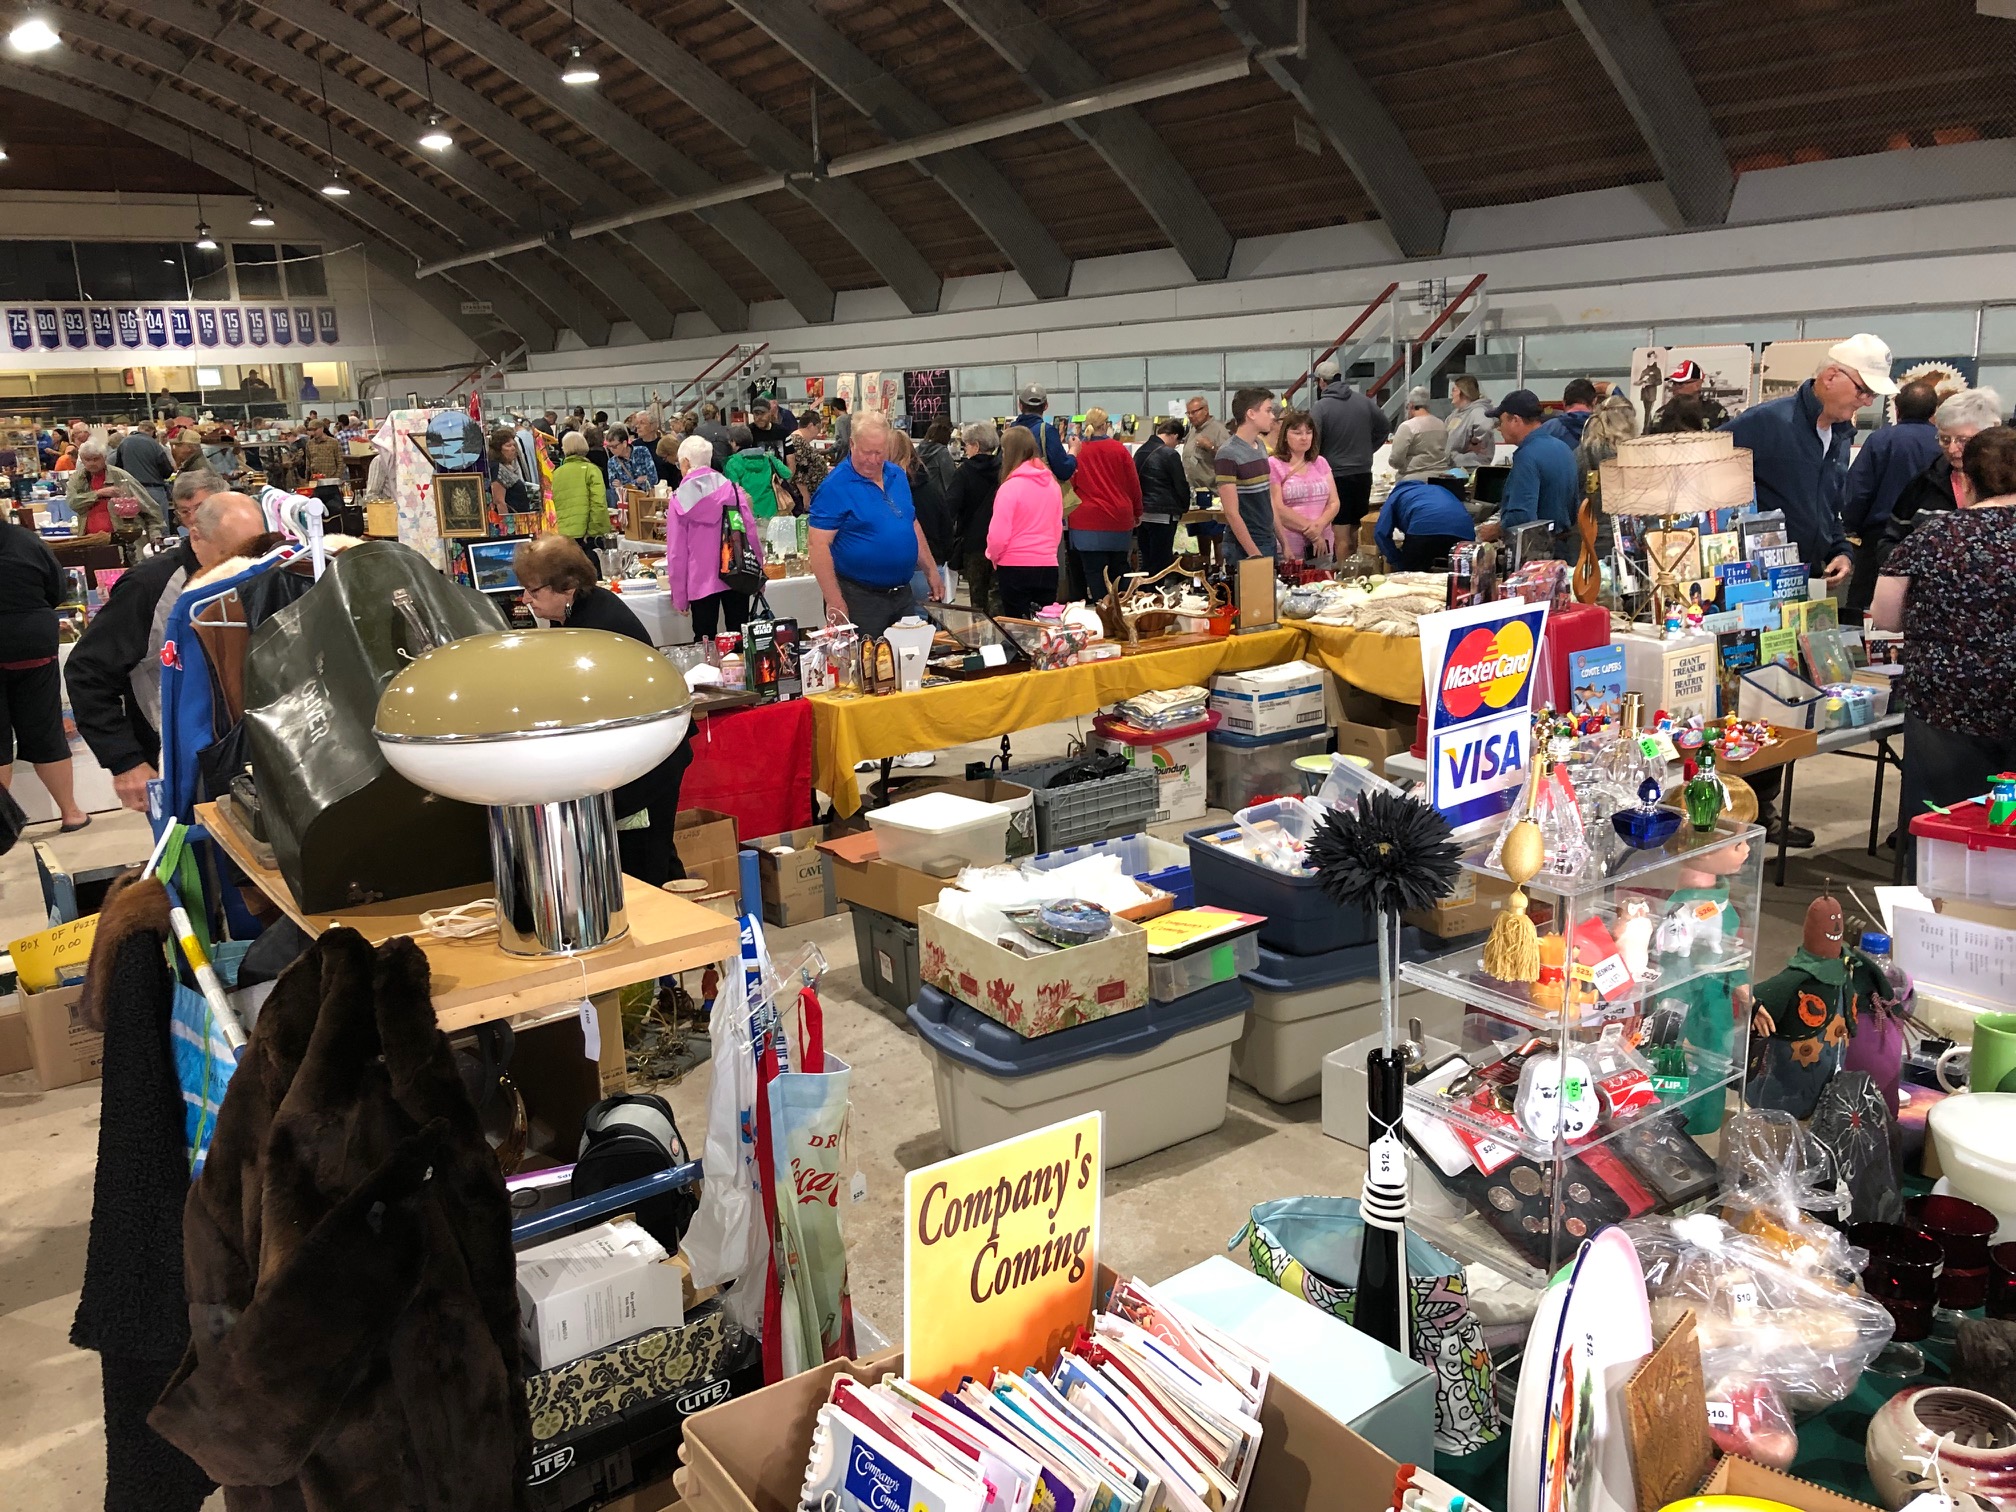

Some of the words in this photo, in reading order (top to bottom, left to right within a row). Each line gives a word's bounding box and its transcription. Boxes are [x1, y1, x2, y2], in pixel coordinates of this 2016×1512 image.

[1726, 568, 1748, 577] Three
[1776, 576, 1804, 589] TRUE
[1773, 586, 1808, 599] NORTH
[1444, 649, 1532, 691] MasterCard
[1581, 666, 1601, 679] COYOTE
[1602, 661, 1622, 674] CAPERS
[1672, 663, 1706, 677] TREASURY
[1679, 656, 1701, 668] GIANT
[1674, 676, 1704, 690] BEATRIX
[1675, 685, 1702, 698] POTTER
[301, 679, 330, 744] OLIVER
[1443, 730, 1522, 790] VISA
[1154, 764, 1187, 776] Roundup
[20, 938, 40, 953] BOX
[51, 928, 66, 942] OF
[918, 1132, 1092, 1246] Company's
[970, 1222, 1091, 1304] Coming
[684, 1382, 723, 1411] LITE
